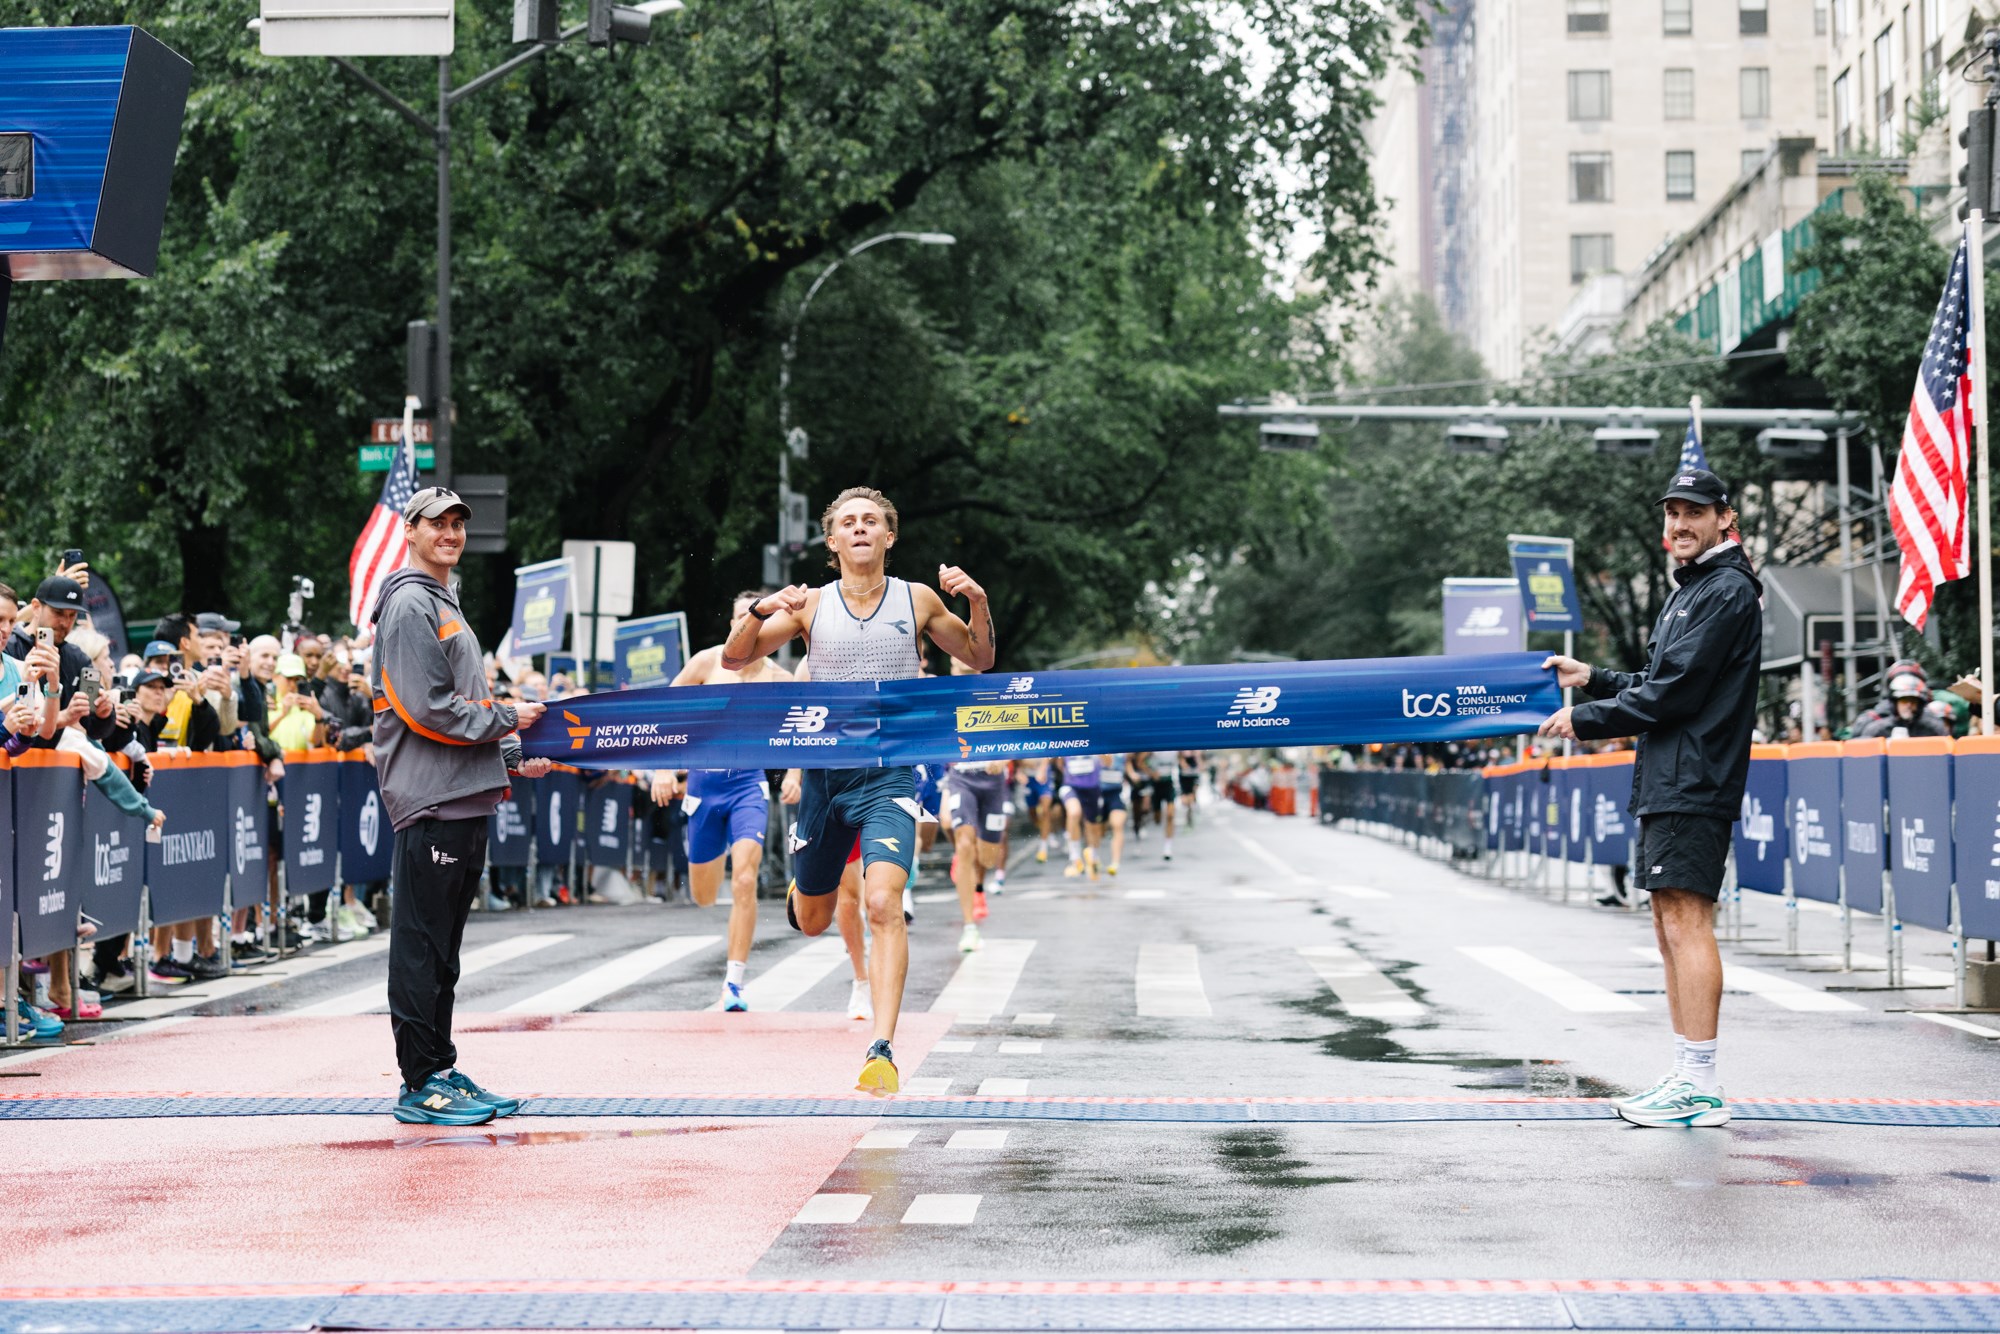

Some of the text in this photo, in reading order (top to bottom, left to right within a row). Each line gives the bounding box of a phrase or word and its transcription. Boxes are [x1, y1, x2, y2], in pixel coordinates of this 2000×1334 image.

[1013, 692, 1039, 700] balance
[1456, 685, 1487, 695] TATA
[1402, 688, 1451, 718] tcs
[1456, 694, 1527, 706] CONSULTANCY
[1456, 705, 1502, 716] SERVICES
[965, 710, 992, 728] 5th
[1033, 706, 1085, 725] MILE
[1216, 717, 1291, 728] new balance
[595, 723, 659, 737] NEW YORK
[595, 734, 689, 749] ROAD RUNNERS
[769, 736, 838, 746] new balance
[975, 739, 1090, 754] NEW YORK ROAD RUNNERS
